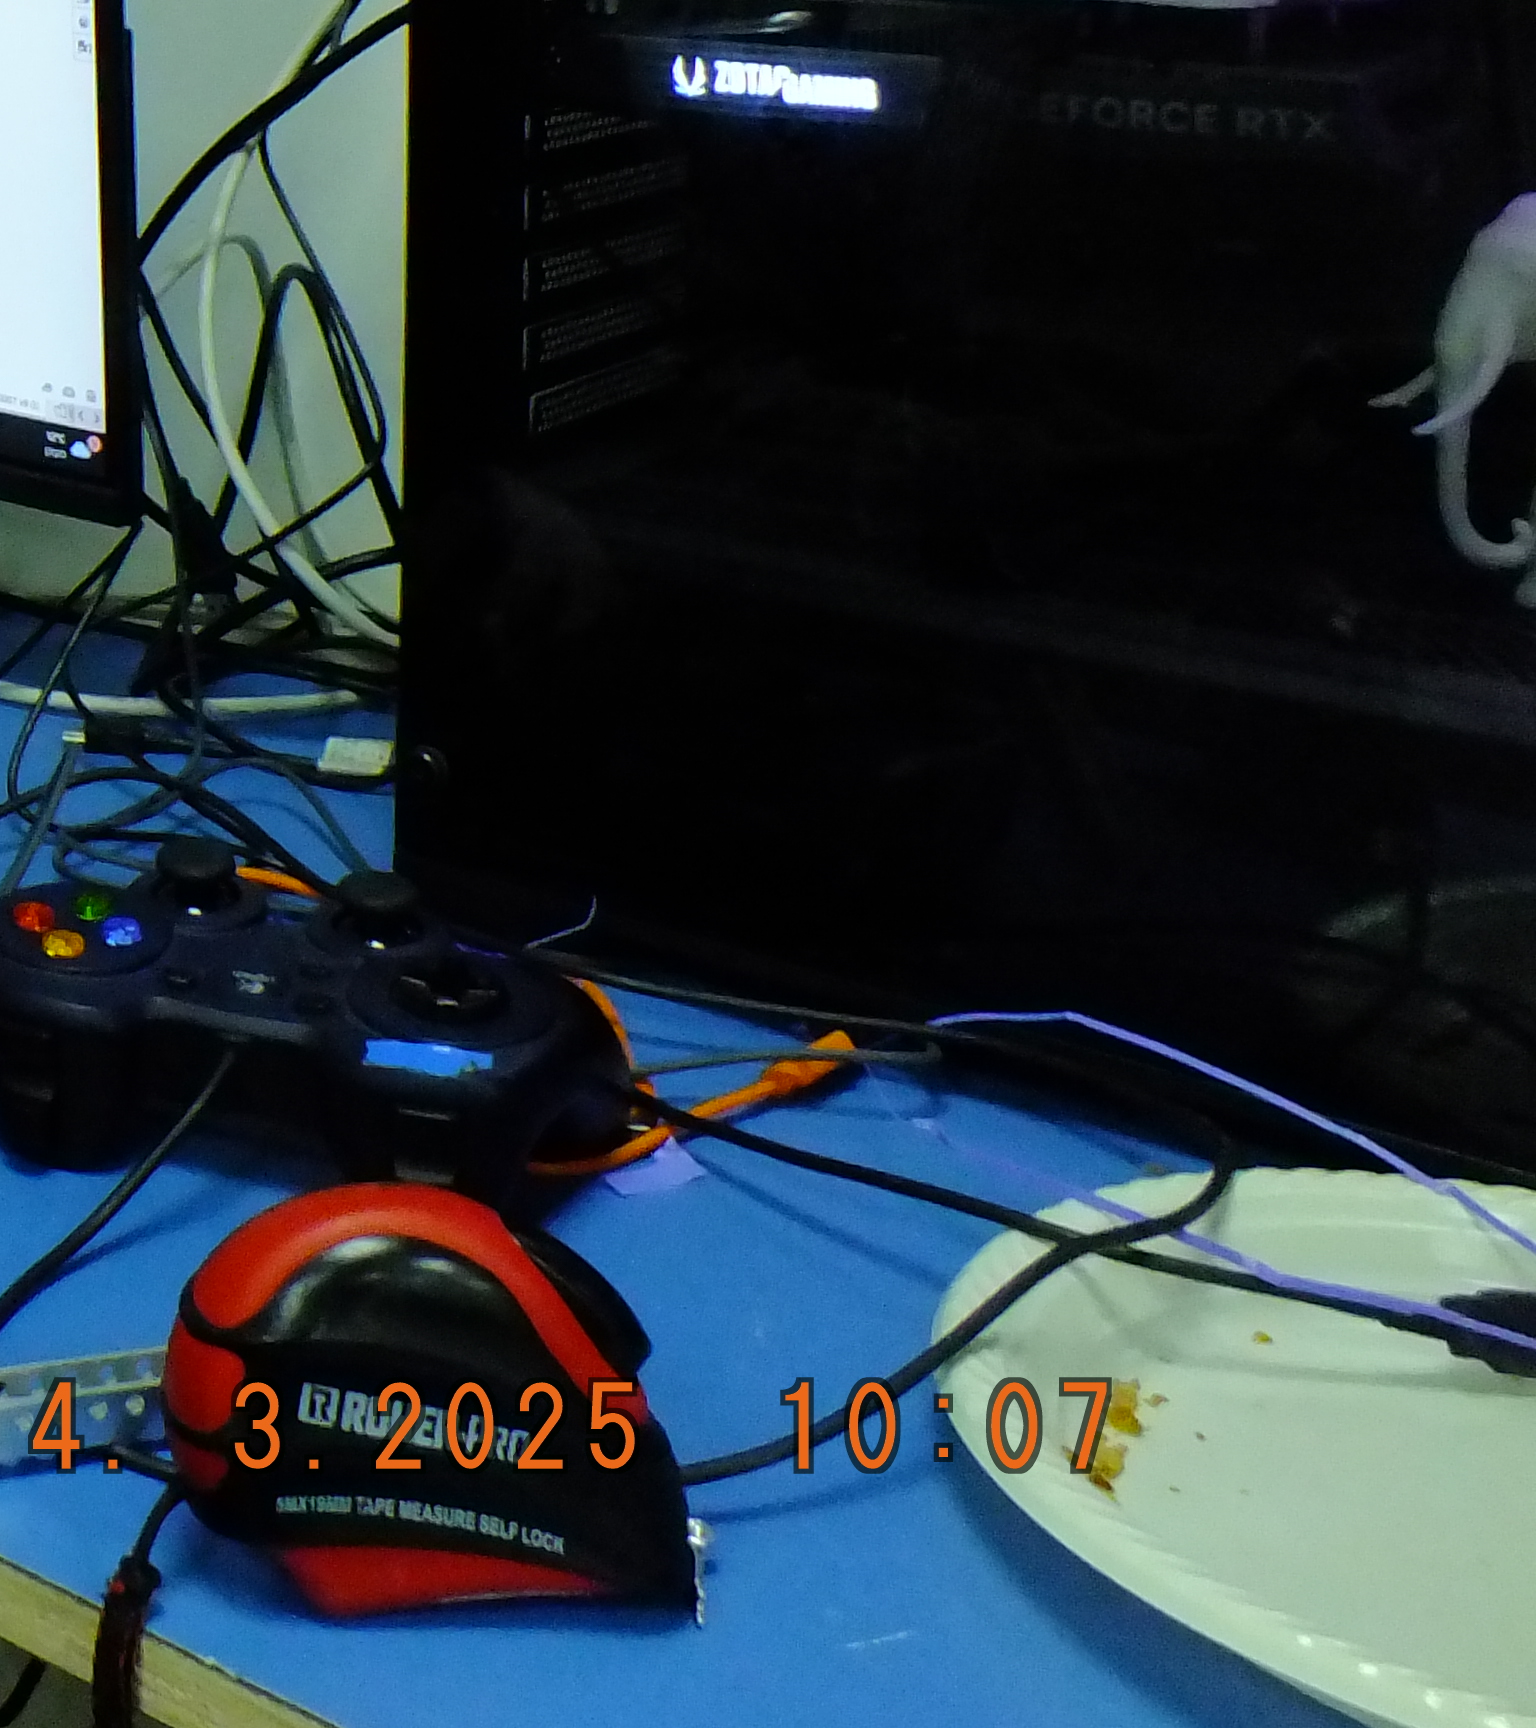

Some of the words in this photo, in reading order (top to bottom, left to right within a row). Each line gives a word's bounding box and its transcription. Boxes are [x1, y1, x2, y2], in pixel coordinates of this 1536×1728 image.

[1233, 105, 1337, 142] RTX
[355, 1495, 396, 1519] TAPE
[398, 1499, 477, 1533] MEASURE
[479, 1512, 519, 1542] SELF
[520, 1525, 566, 1556] LOCK
